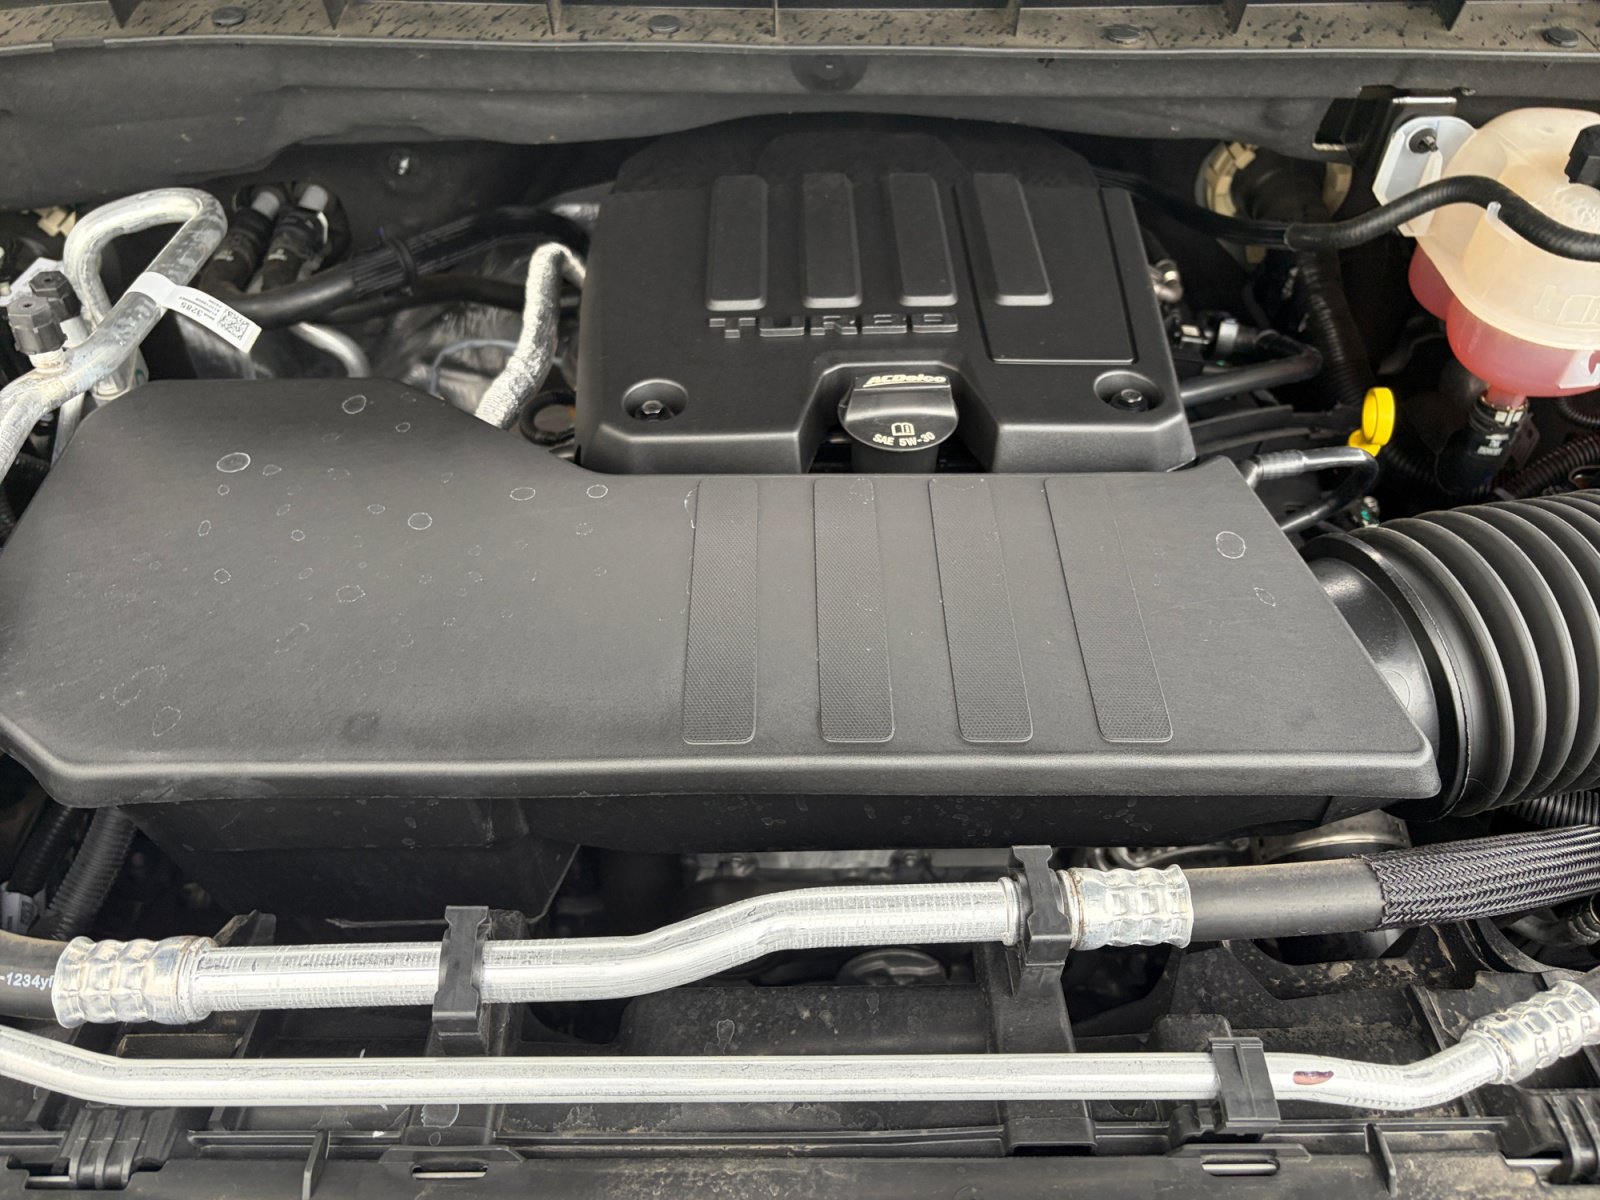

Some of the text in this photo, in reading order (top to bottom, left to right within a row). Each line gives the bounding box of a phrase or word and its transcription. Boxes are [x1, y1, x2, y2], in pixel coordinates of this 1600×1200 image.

[180, 302, 204, 317] 3285
[863, 374, 947, 387] ACDelco
[872, 431, 936, 447] SAE 5W-30
